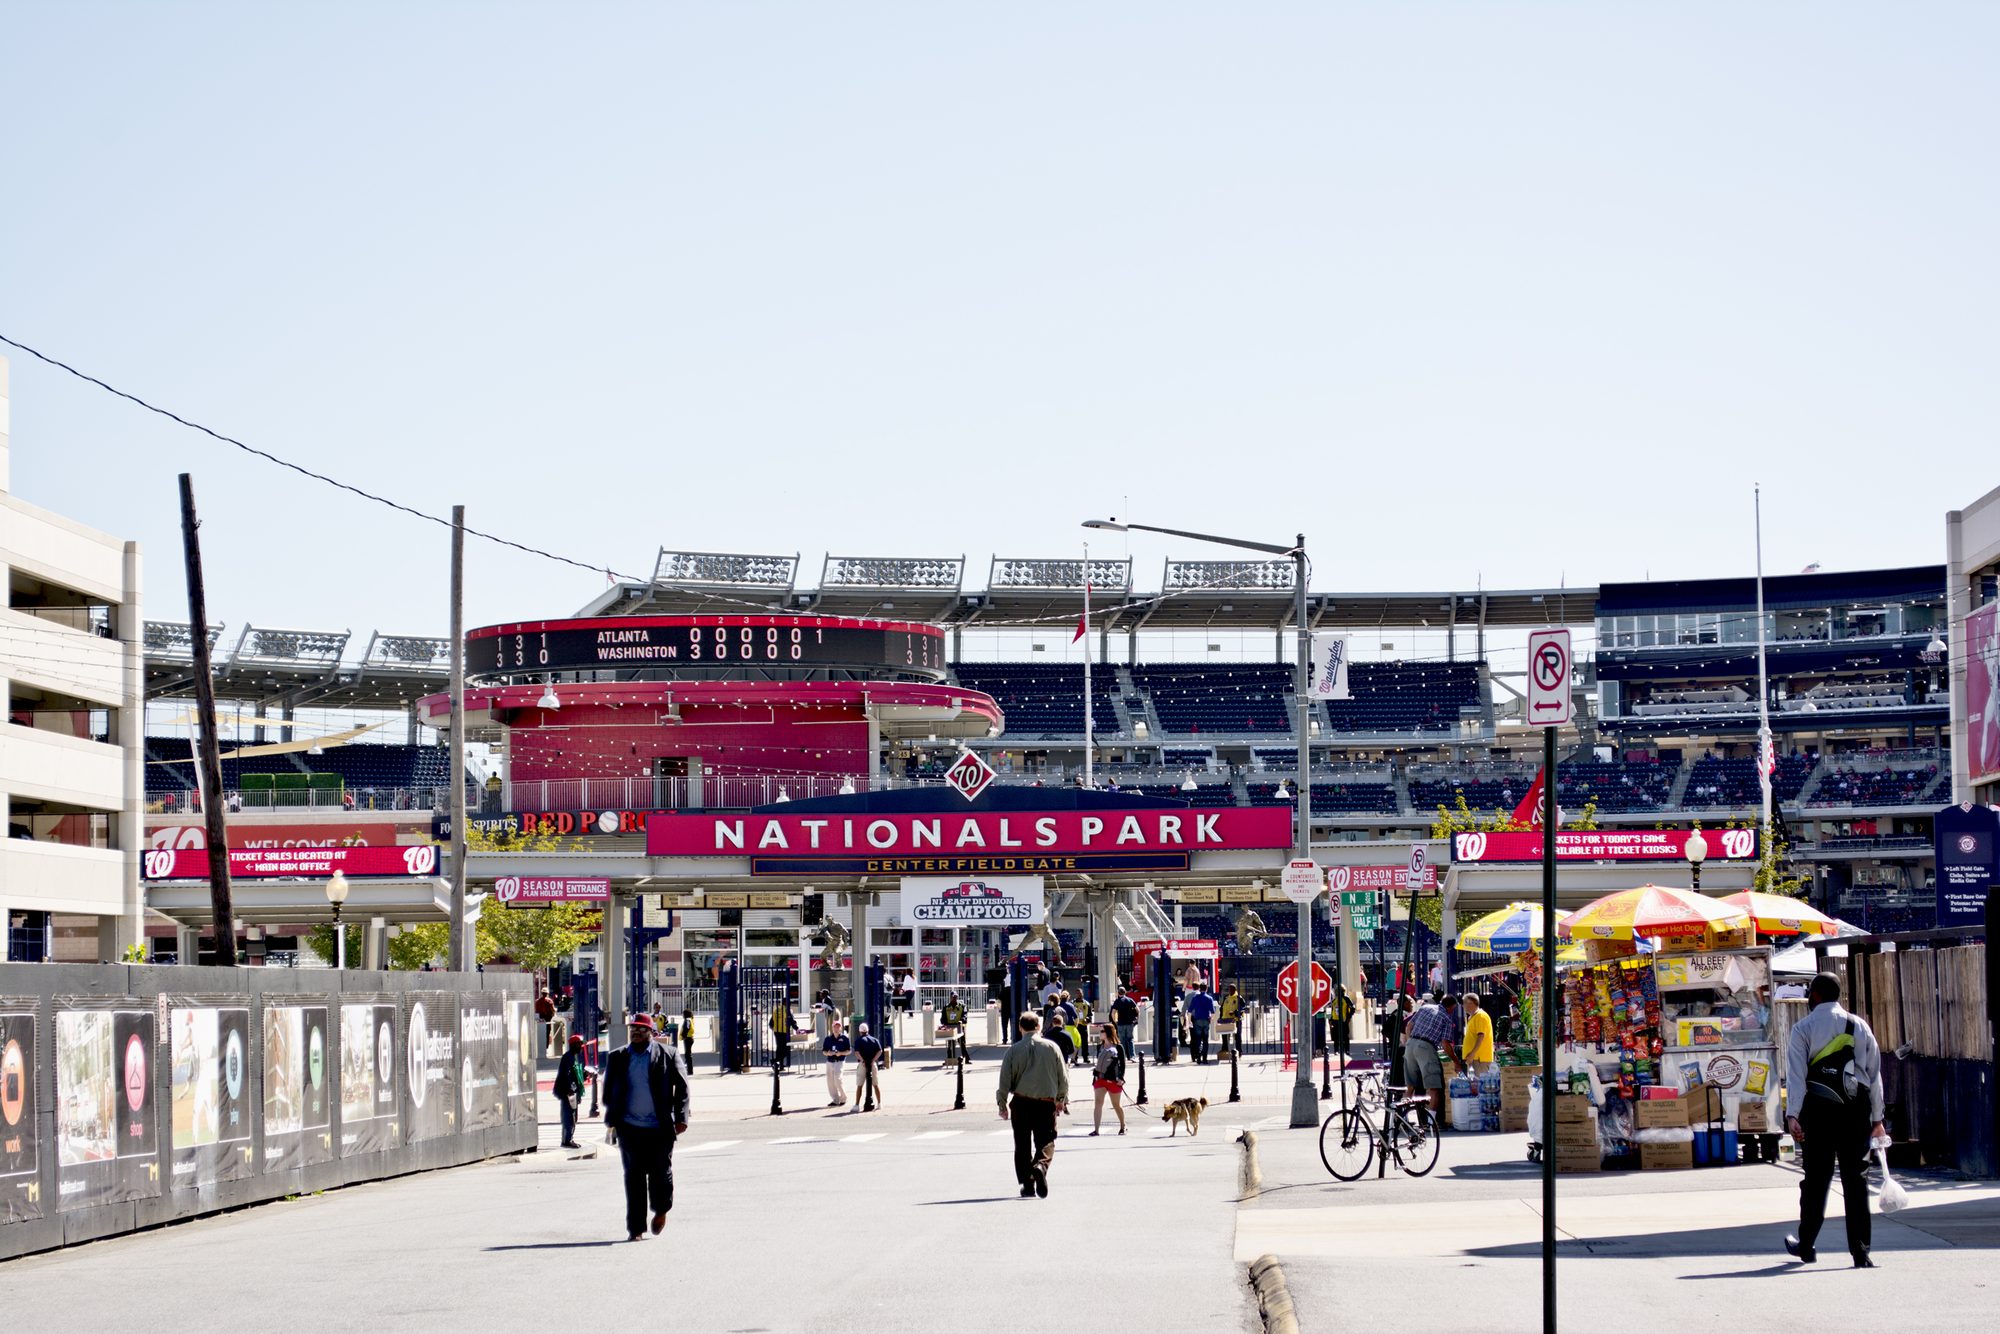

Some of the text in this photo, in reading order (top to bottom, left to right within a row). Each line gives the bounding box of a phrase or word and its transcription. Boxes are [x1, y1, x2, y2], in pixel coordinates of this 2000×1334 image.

[692, 616, 696, 624] 1
[542, 622, 546, 630] E
[597, 627, 822, 644] ATLANTA 0 0 0 0 0 1
[497, 632, 546, 652] 1 3 1
[907, 634, 912, 649] 1
[922, 636, 928, 650] 3
[597, 644, 801, 660] WASHINGTON 3 0 0 0 0
[496, 650, 548, 668] 3 3 0
[906, 650, 912, 665] 3
[922, 651, 928, 666] 3
[1319, 640, 1344, 694] Washington
[522, 812, 574, 832] RED
[714, 814, 1224, 849] NATIONALS PARK
[1582, 834, 1667, 844] FOR TODAY'S GAME
[1594, 844, 1678, 854] AT TICKET KIOSKS
[230, 850, 347, 860] TICKET SALES LOCATED AT
[255, 862, 331, 872] MAIN BOX OFFICE
[867, 856, 1076, 872] CENTER FIELD GATE
[1353, 870, 1392, 879] SEASON
[522, 880, 564, 890] SEASON
[566, 884, 607, 894] ENTRANCE
[1350, 893, 1356, 904] N
[914, 905, 1031, 919] CHAMPIONS
[1351, 906, 1370, 914] UNIT
[1354, 916, 1371, 928] HALF
[1360, 930, 1374, 940] 1200
[1640, 924, 1704, 936] All Beef Hot Dogs
[1464, 937, 1488, 948] SABRETT
[1670, 936, 1682, 944] utz
[1691, 956, 1726, 966] ALL BEEF
[462, 1008, 502, 1042] halfstreet.com
[1702, 1026, 1712, 1034] NO
[426, 1030, 453, 1060] halfstreet
[1716, 1066, 1744, 1076] NATURAL
[130, 1120, 144, 1137] shop
[6, 1136, 20, 1152] work
